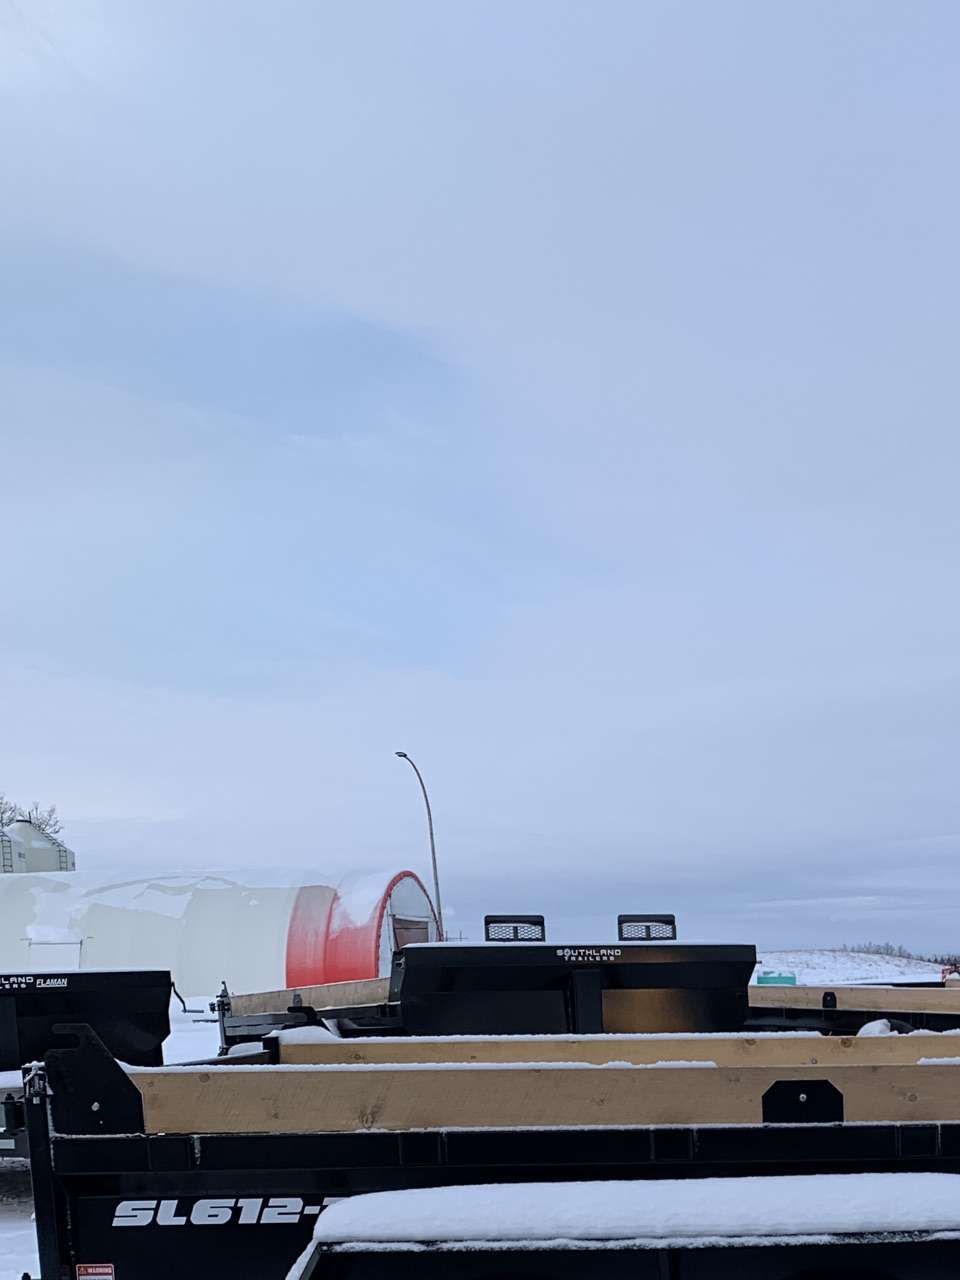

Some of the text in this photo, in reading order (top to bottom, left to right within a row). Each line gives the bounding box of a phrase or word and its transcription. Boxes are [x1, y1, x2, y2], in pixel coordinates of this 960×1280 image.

[0, 976, 34, 984] LAND
[36, 977, 68, 987] FLAMAN
[111, 1197, 340, 1227] SL612-
